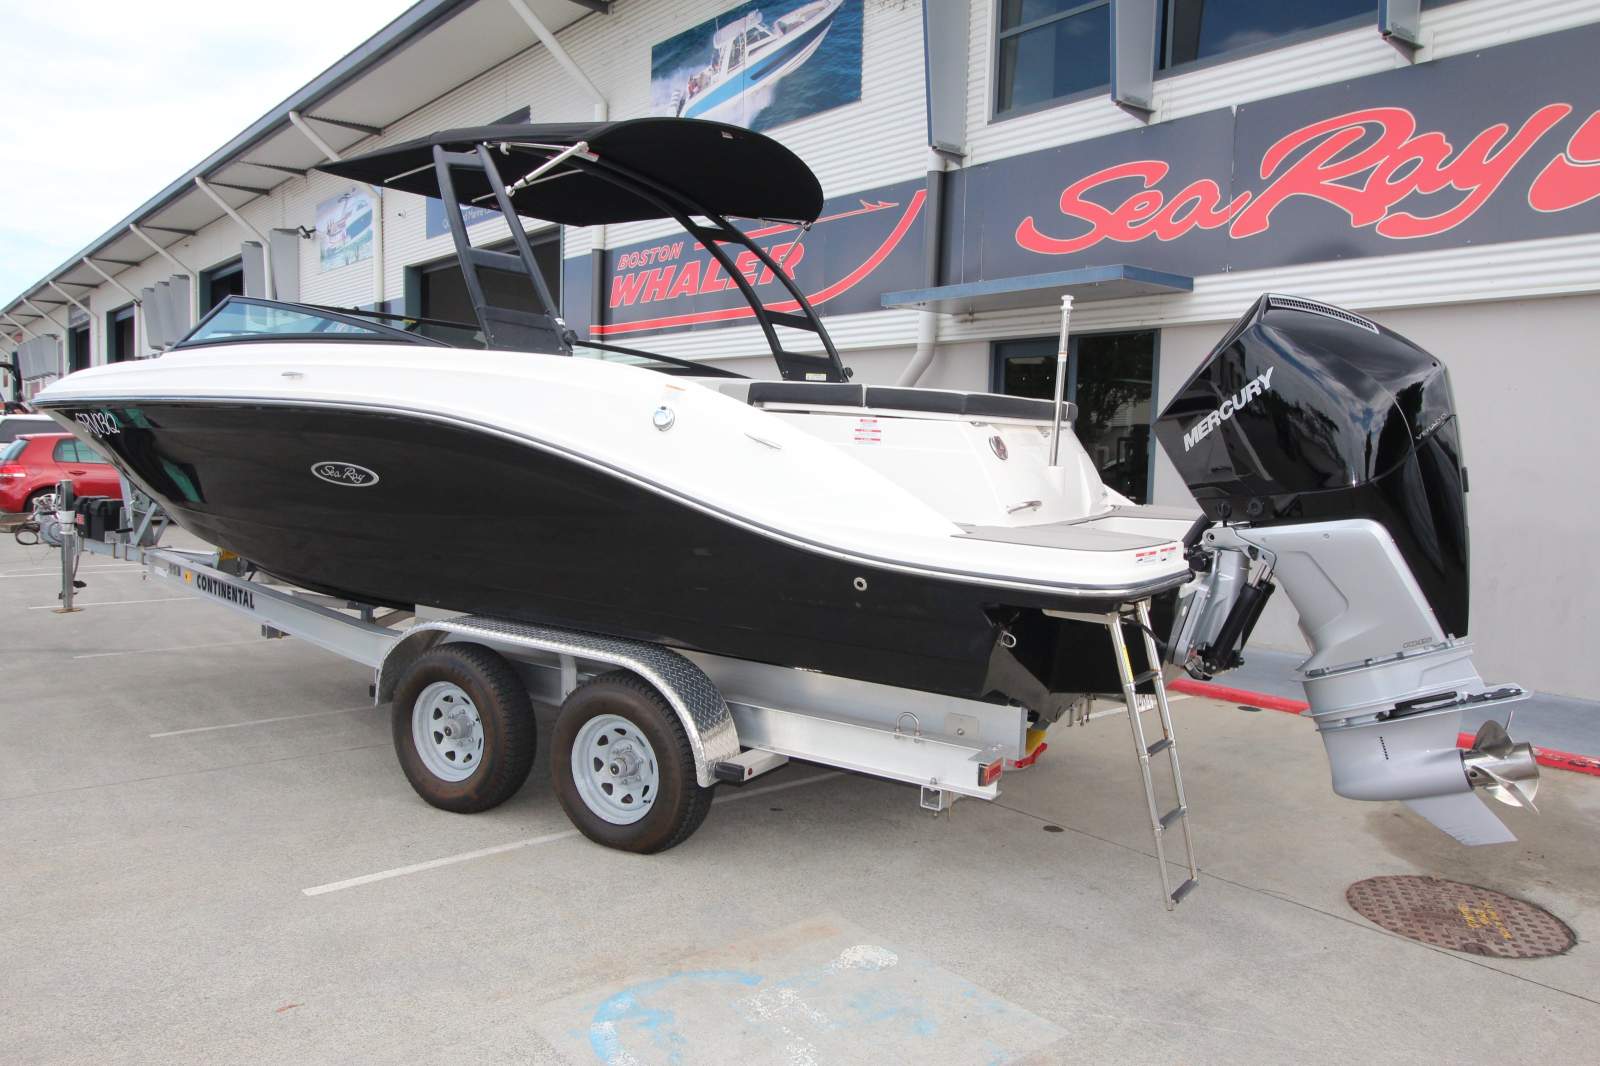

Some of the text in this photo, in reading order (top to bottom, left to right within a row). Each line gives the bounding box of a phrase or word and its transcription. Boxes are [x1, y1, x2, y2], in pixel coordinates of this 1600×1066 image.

[1015, 102, 1573, 254] Sea Ray
[609, 242, 805, 309] WHALER
[617, 241, 684, 270] BOSTON
[1183, 365, 1274, 453] MERCURY
[320, 465, 366, 484] Sea Ray
[196, 574, 255, 609] CONTINENTAL
